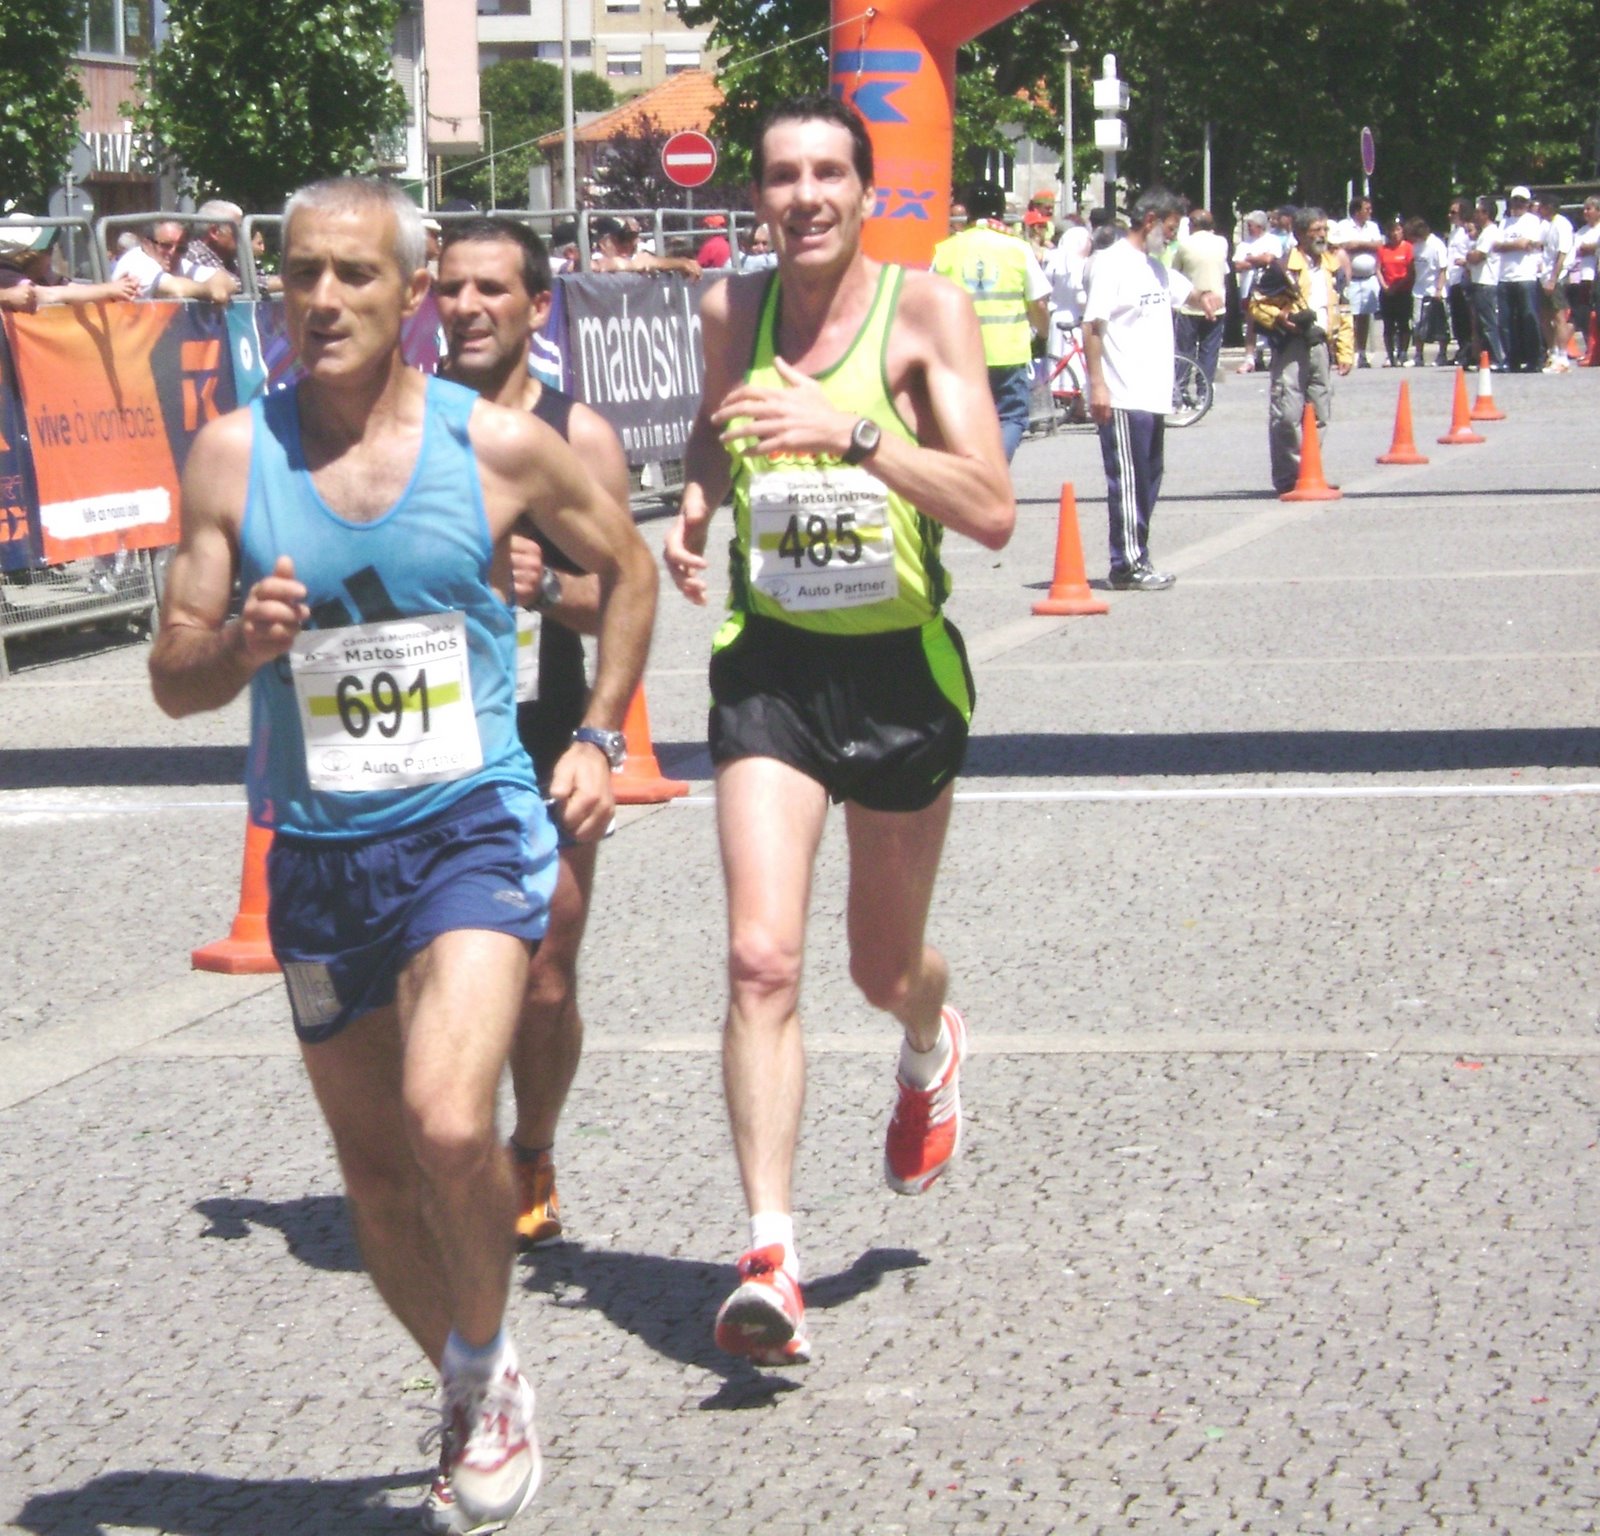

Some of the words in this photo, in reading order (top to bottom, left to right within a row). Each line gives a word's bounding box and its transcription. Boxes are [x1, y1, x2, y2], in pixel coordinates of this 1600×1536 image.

[34, 403, 72, 448] vive
[89, 397, 156, 443] vontade
[788, 490, 880, 505] Matosinhos
[779, 512, 863, 569] 485
[797, 584, 831, 597] Auto
[834, 580, 886, 595] Partner
[342, 634, 386, 648] Câmara
[344, 637, 459, 664] Matosinhos
[336, 668, 431, 739] 691
[361, 759, 400, 775] Auto
